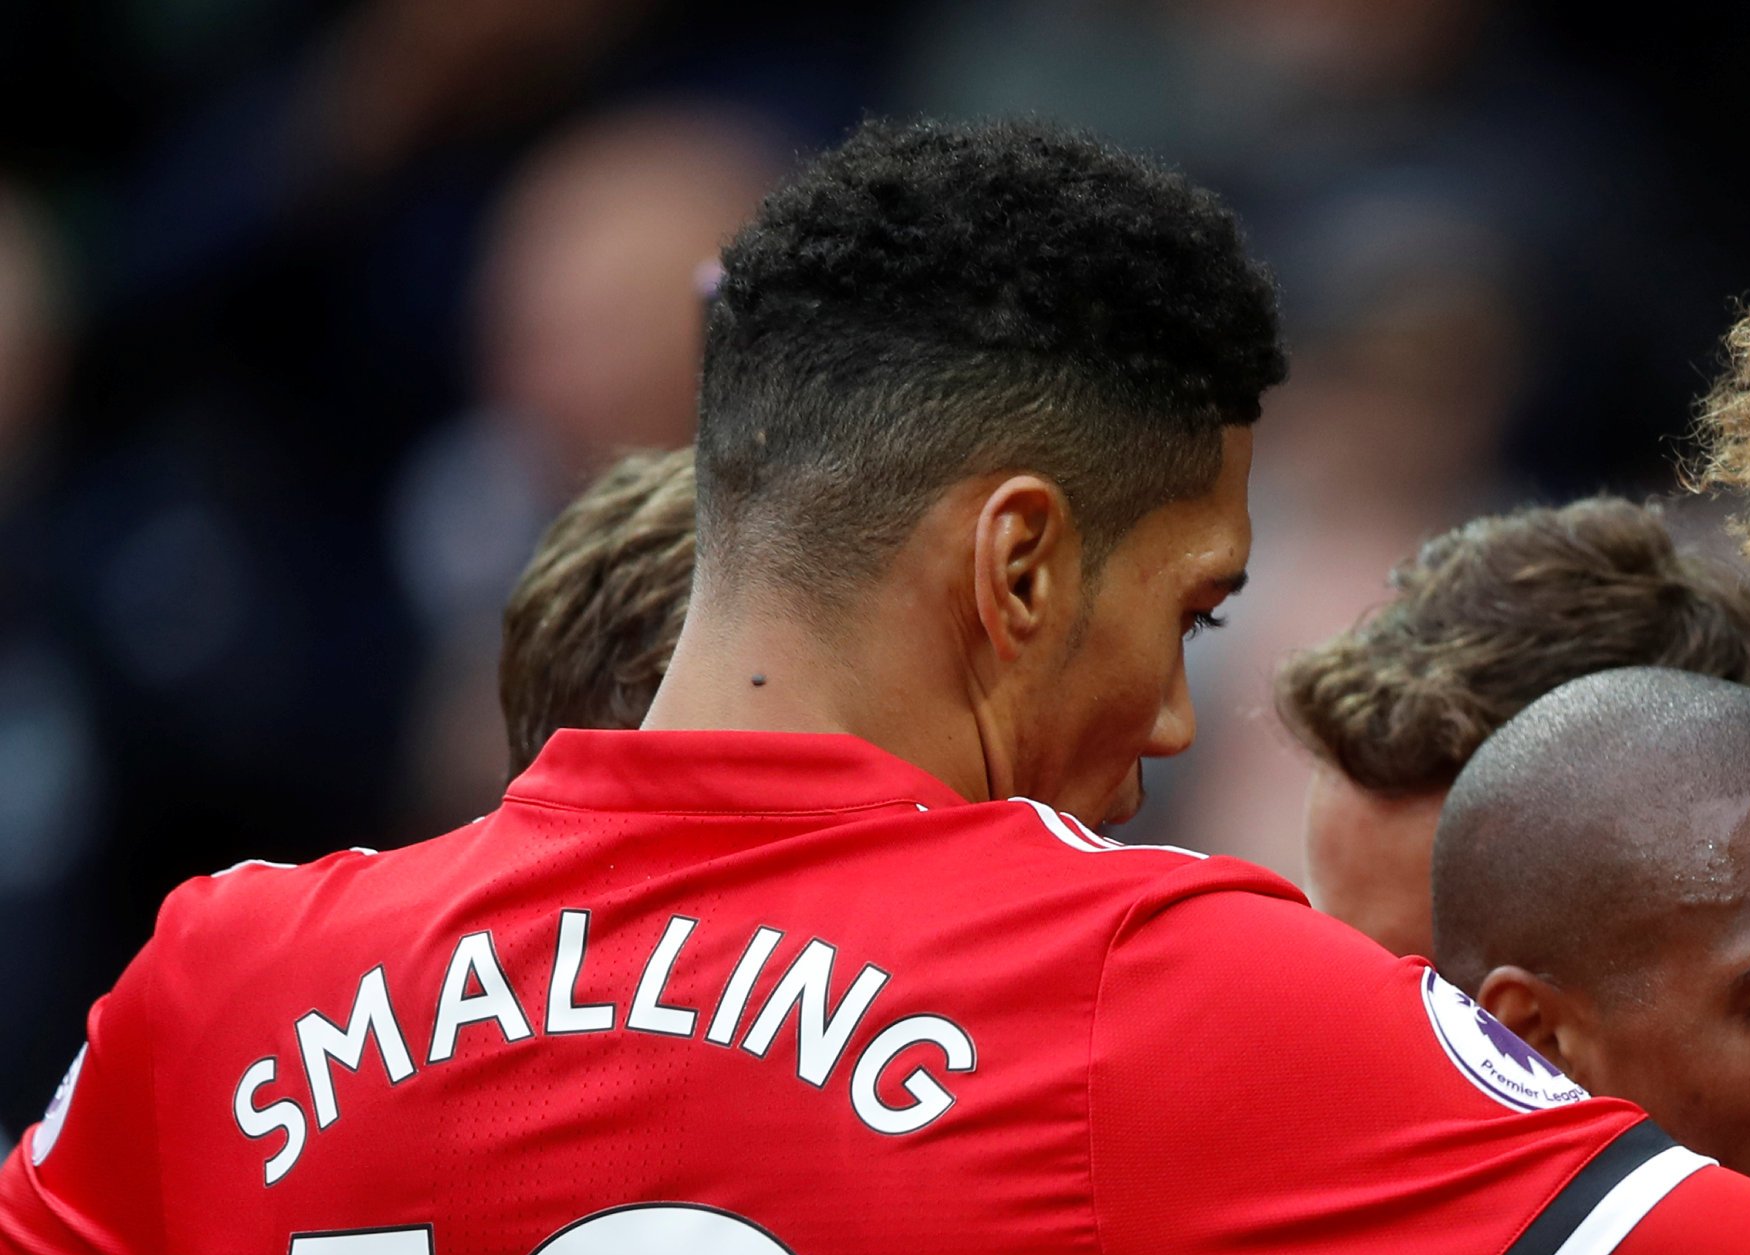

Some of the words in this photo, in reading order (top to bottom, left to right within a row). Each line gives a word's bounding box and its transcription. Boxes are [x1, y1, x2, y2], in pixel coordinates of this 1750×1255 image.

[231, 907, 978, 1188] SMALLING
[1480, 1058, 1539, 1100] Premier
[1542, 1086, 1585, 1103] Leagu
